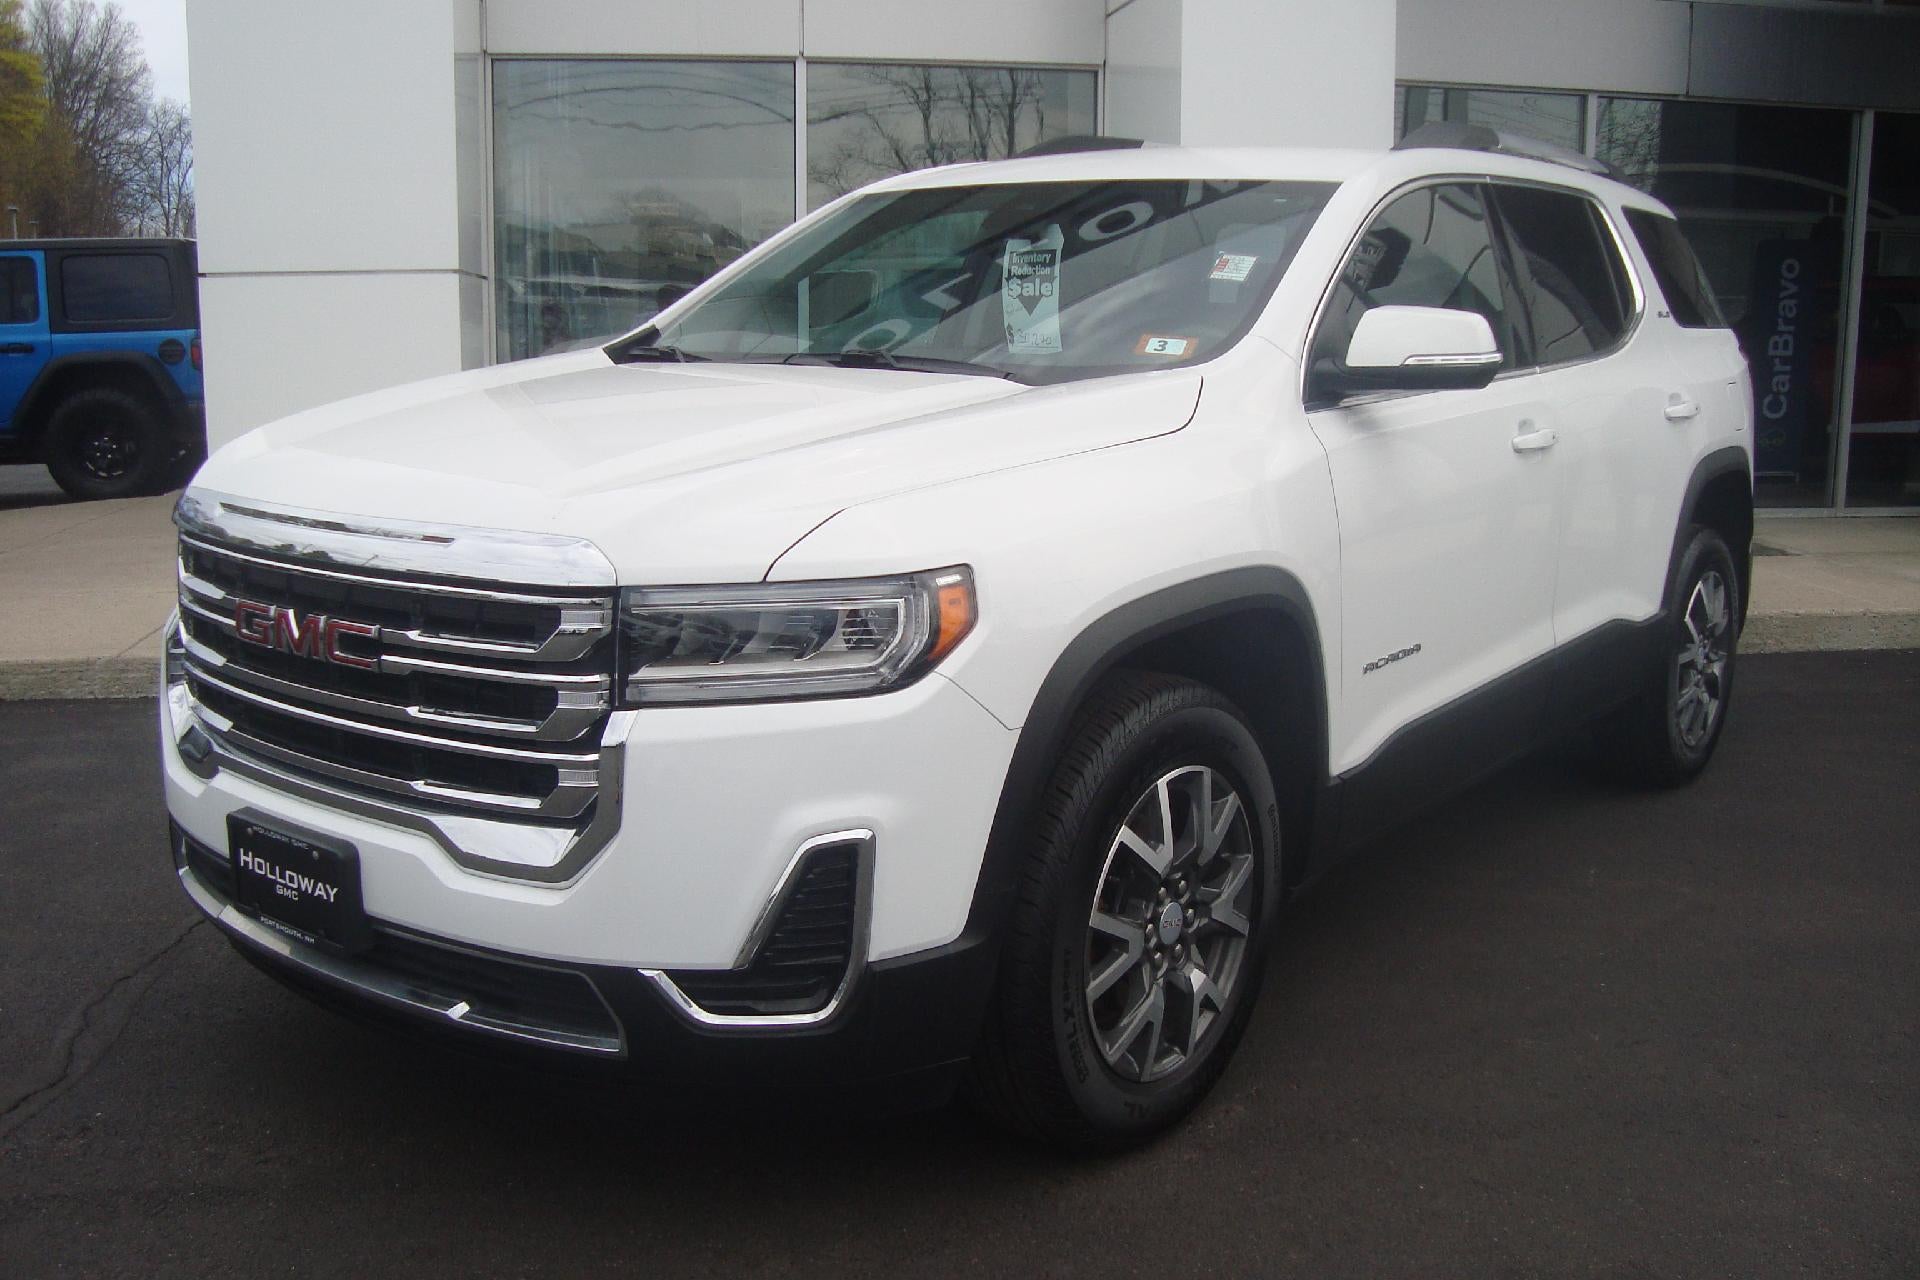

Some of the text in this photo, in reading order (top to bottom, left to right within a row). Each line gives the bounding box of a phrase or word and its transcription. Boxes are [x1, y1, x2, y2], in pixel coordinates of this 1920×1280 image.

[1012, 252, 1052, 264] Inventory
[1010, 264, 1051, 277] Reduction
[1153, 339, 1169, 352] 3
[1762, 258, 1800, 419] CarBravo
[234, 598, 382, 673] GMC
[1362, 643, 1422, 675] ACADIA
[239, 847, 339, 902] HOLLOWAY
[275, 884, 299, 900] GMC
